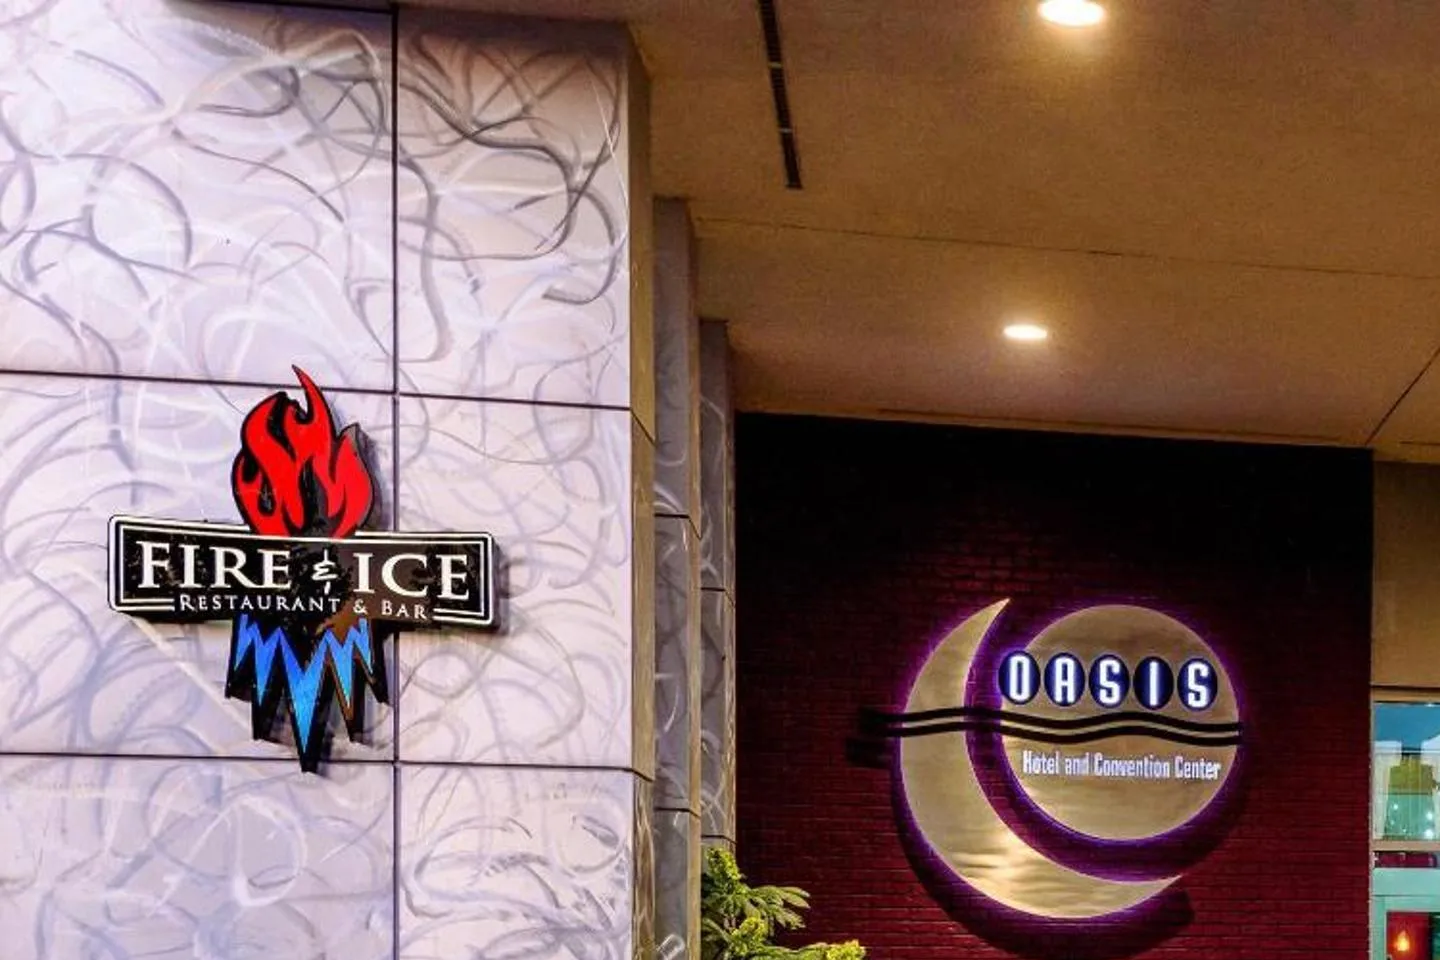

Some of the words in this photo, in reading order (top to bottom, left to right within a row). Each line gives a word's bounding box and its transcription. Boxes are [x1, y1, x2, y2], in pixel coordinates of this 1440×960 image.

[136, 540, 292, 589] FIRE
[311, 549, 339, 595] &
[352, 552, 470, 600] ICE
[179, 593, 341, 613] RESTAURANT
[352, 598, 368, 615] &
[381, 599, 428, 620] BAR
[1008, 654, 1210, 708] OASIS
[1022, 750, 1060, 774] Hotel
[1064, 752, 1090, 776] and
[1094, 751, 1171, 779] Convention
[1174, 755, 1222, 781] Center
